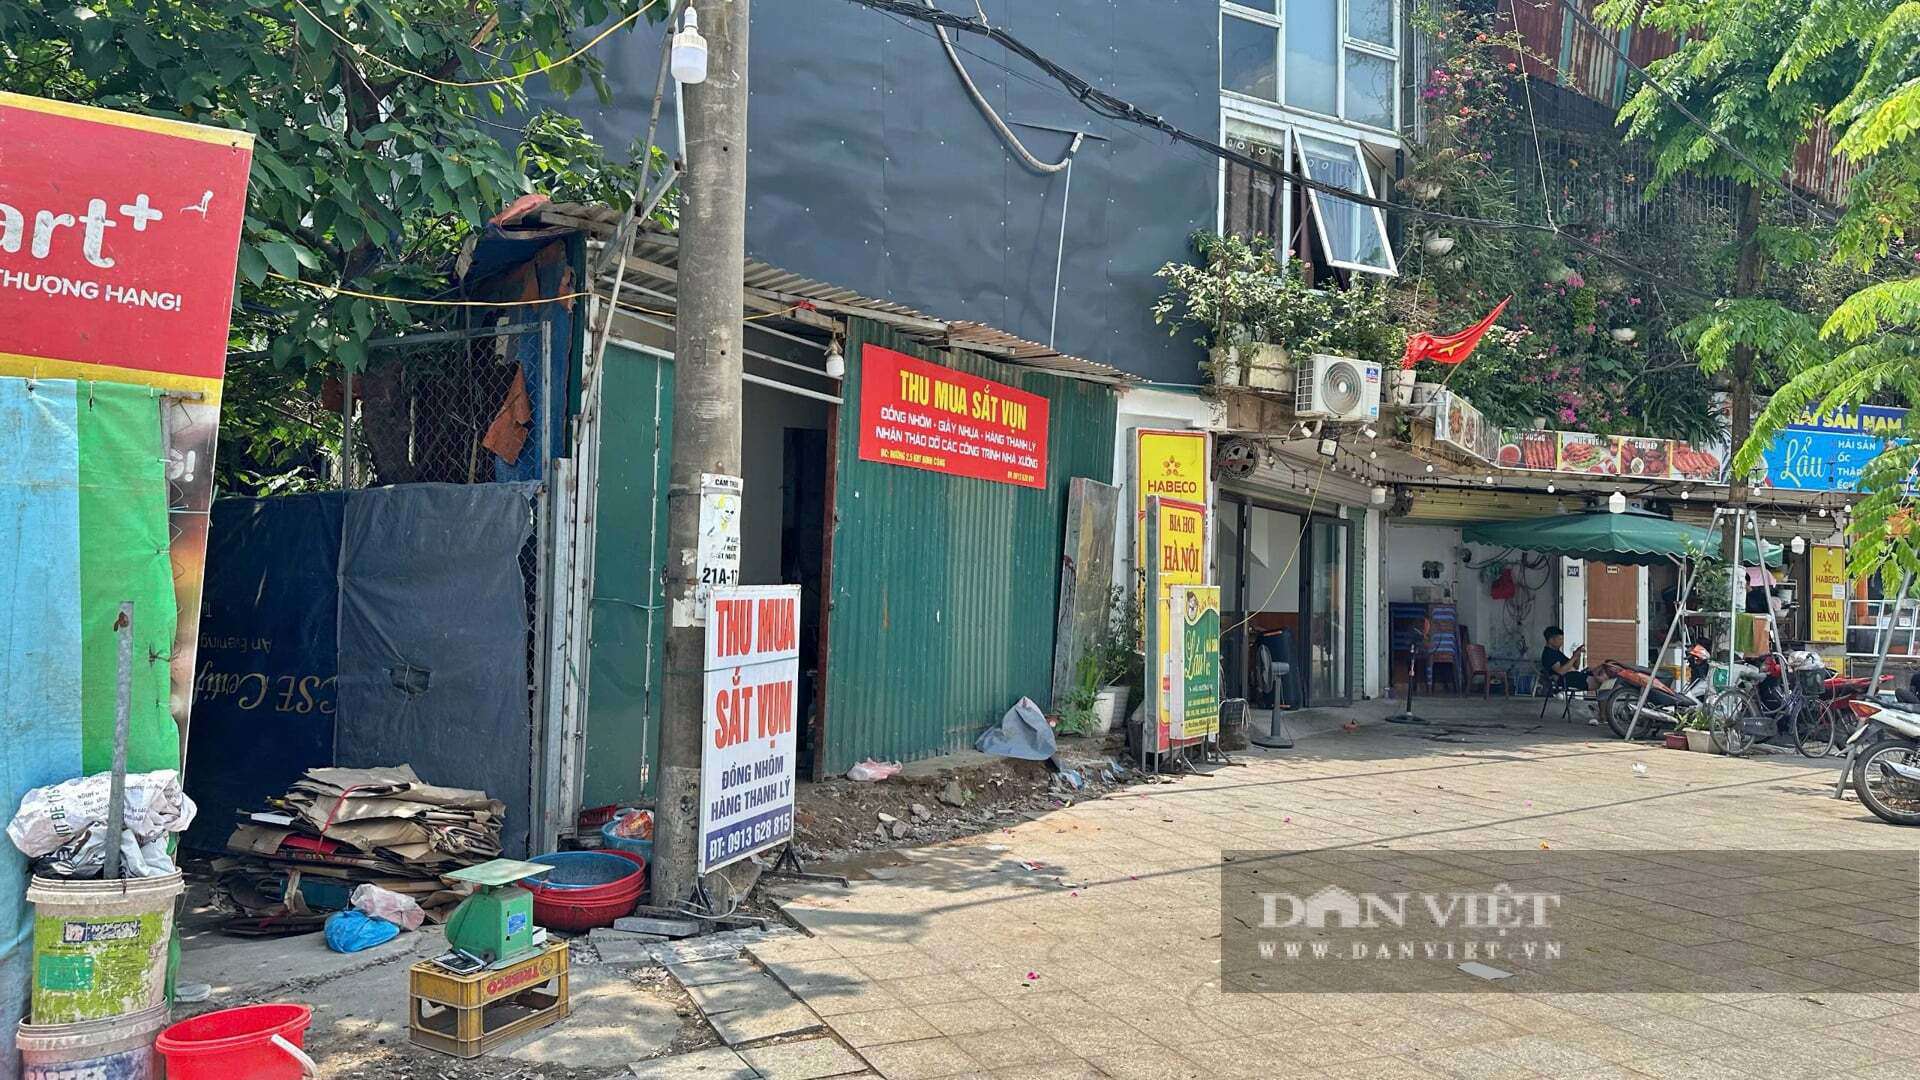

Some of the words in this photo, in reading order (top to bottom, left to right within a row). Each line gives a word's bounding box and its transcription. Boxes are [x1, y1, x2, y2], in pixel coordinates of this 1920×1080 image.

[0, 268, 99, 300] HƯỢNG
[900, 369, 930, 406] THU
[934, 379, 968, 416] MUA
[971, 383, 998, 423] SẮT
[1001, 399, 1027, 433] VỤN
[1862, 414, 1902, 432] NAM
[1006, 435, 1028, 450] THANH
[1838, 438, 1855, 449] HẢI
[1856, 439, 1876, 451] SẢN
[1147, 479, 1197, 494] HABECO
[1169, 514, 1181, 532] BIA
[1163, 537, 1179, 571] HÀ
[1181, 541, 1200, 579] NỘI
[715, 599, 753, 658] THU
[757, 598, 796, 654] MUA
[251, 637, 273, 654] An
[714, 666, 753, 750] SẮT
[757, 680, 792, 749] VỤN
[721, 761, 752, 790] ĐỒNG
[754, 754, 784, 780] NHÔM
[711, 795, 741, 822] HÀNG
[744, 783, 777, 810] THANH
[779, 775, 791, 798] LÝ
[709, 837, 726, 861] ĐT:
[727, 826, 753, 854] 0913
[754, 819, 772, 843] 628
[773, 812, 791, 835] 815
